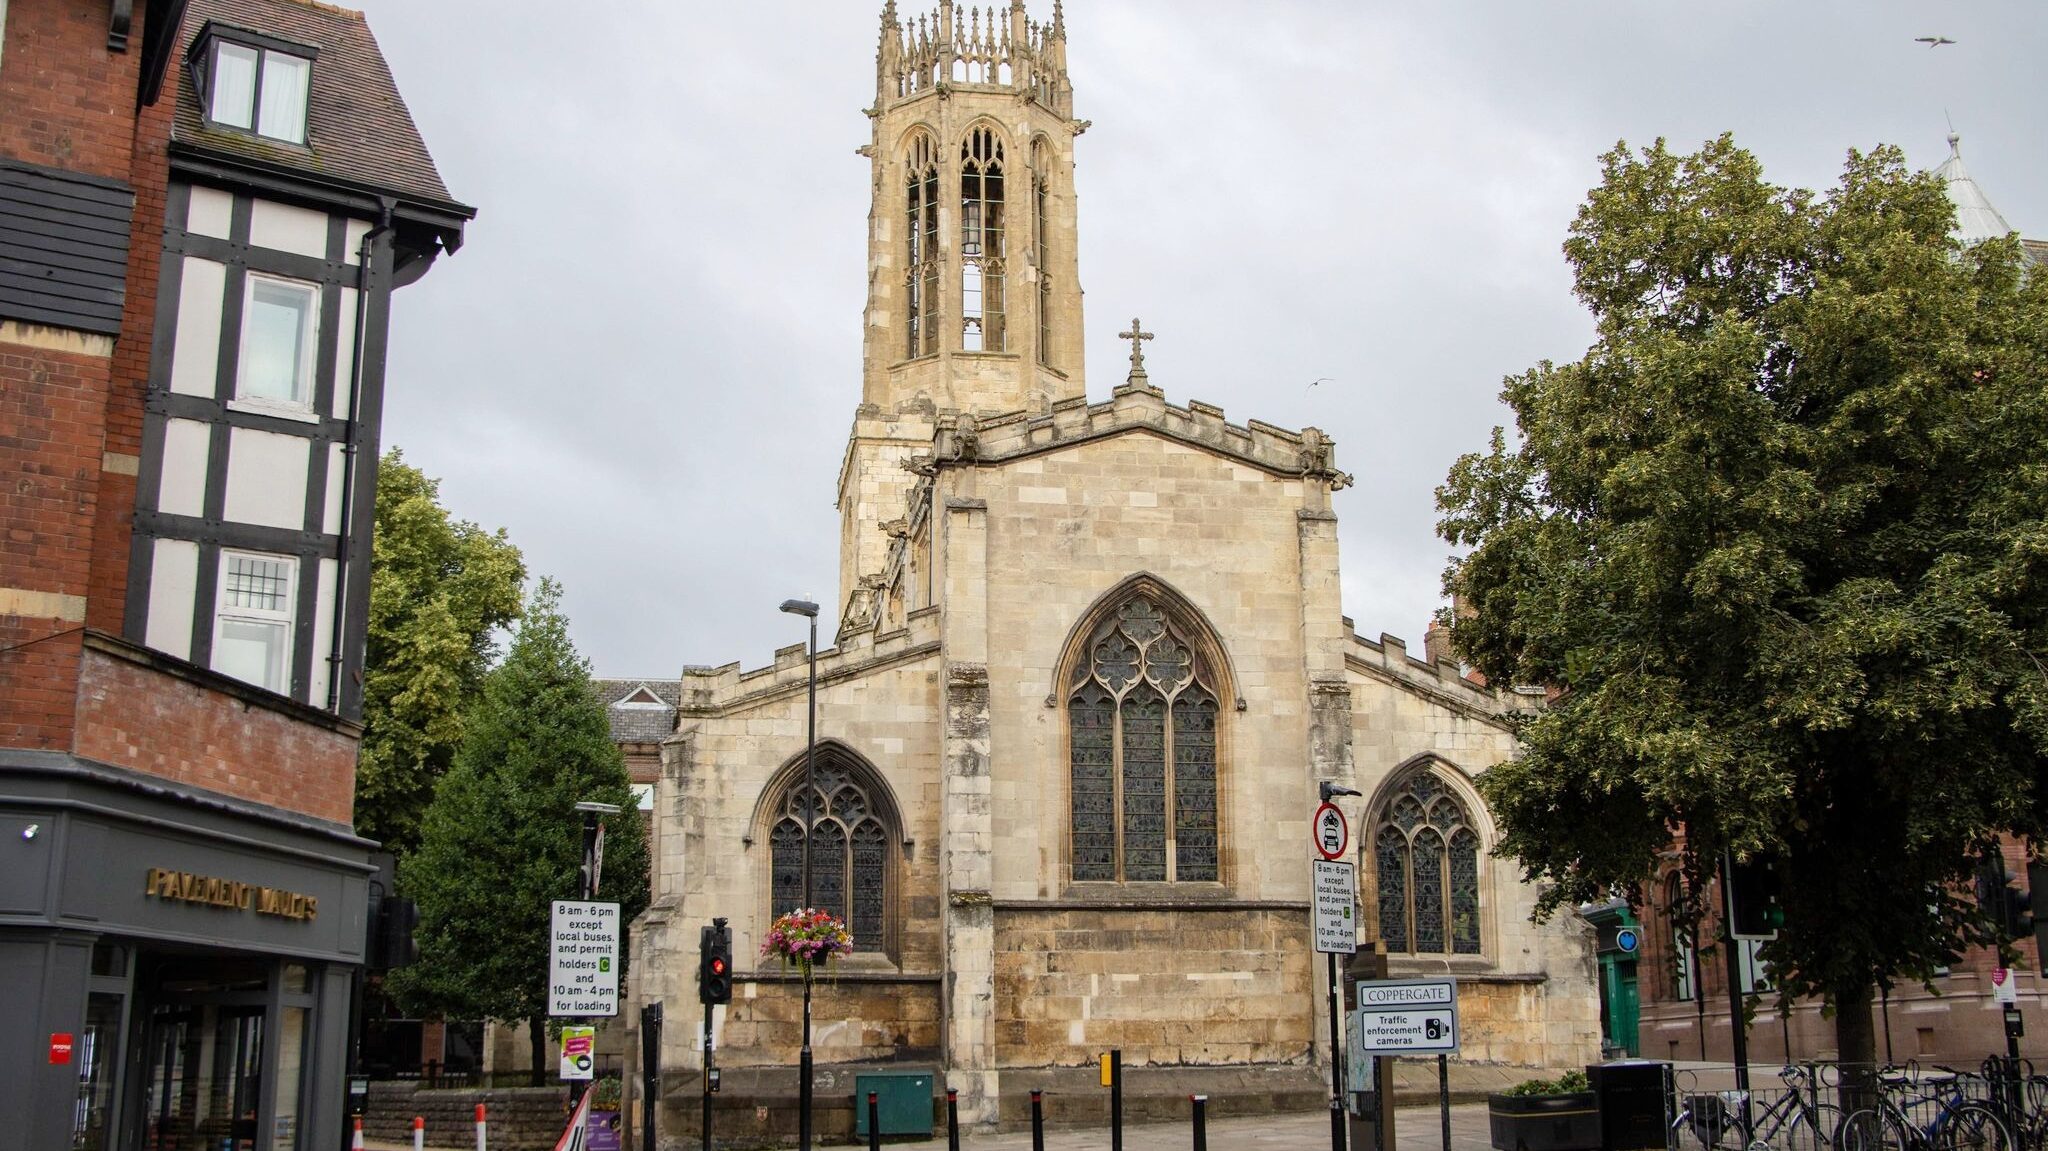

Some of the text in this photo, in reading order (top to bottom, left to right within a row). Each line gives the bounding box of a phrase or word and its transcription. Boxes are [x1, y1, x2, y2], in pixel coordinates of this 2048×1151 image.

[1318, 864, 1322, 872] 8
[1318, 884, 1332, 893] local
[147, 868, 319, 920] PAVEMENT VAULTS
[559, 905, 565, 914] 8
[590, 907, 596, 916] 6
[599, 909, 613, 917] pm
[1320, 908, 1342, 916] holders
[569, 920, 602, 930] except
[556, 931, 580, 940] local
[558, 944, 612, 954] and permit
[1331, 941, 1352, 950] loading
[559, 959, 609, 970] holders C
[576, 974, 594, 983] and
[554, 986, 565, 995] 10
[567, 987, 582, 995] am
[590, 986, 597, 995] 4
[599, 988, 614, 996] pm
[1368, 988, 1445, 1001] COPPERGATE
[557, 1001, 610, 1012] for loading
[1379, 1016, 1407, 1024] Traffic
[1367, 1026, 1422, 1035] enforcement
